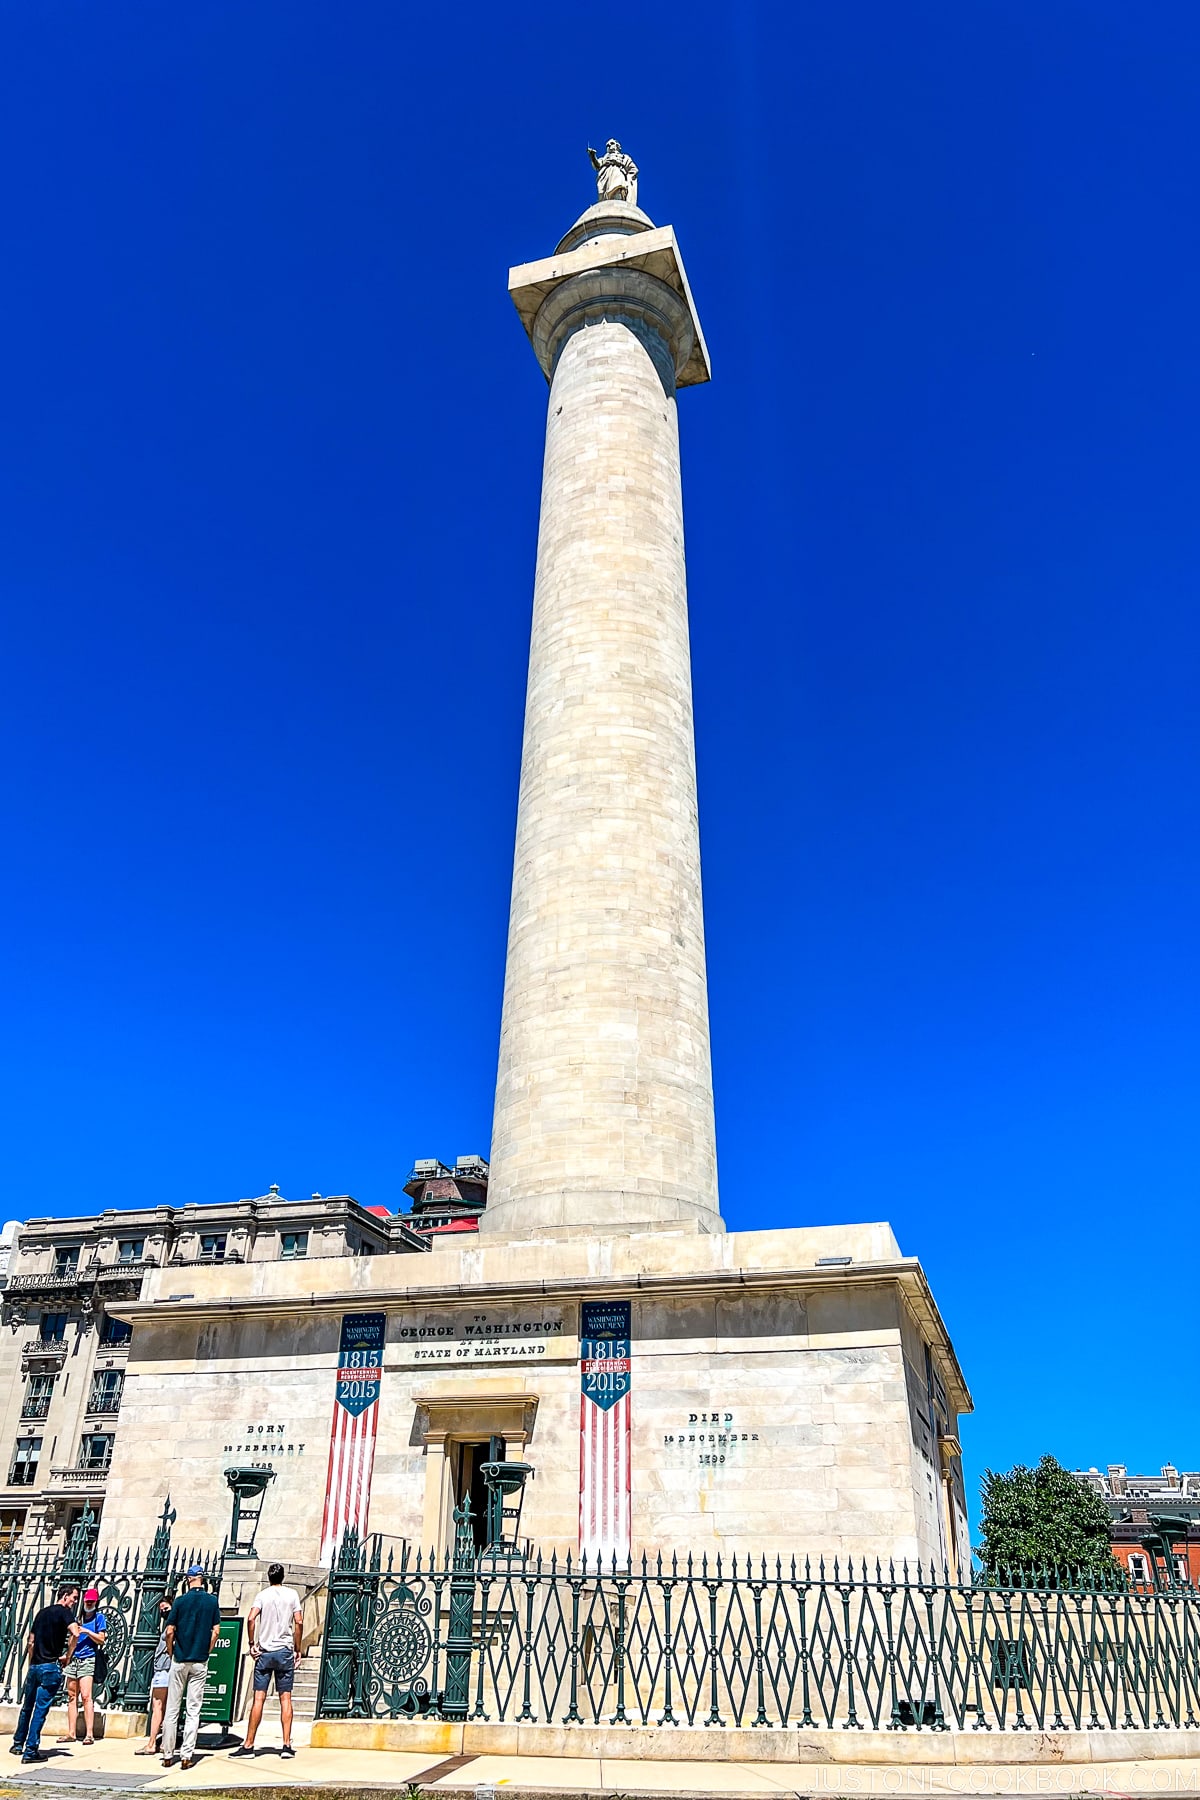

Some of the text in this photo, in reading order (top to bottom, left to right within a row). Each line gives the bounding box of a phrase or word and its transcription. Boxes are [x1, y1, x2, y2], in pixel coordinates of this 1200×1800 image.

[587, 1315, 626, 1324] WASHINGTON
[346, 1326, 380, 1335] WASHINGTON
[401, 1321, 563, 1338] GEORGE WASHINGTON
[588, 1321, 625, 1330] MONUMENT
[346, 1333, 380, 1341] MONUMENT
[414, 1345, 546, 1359] STATE OF MARYLAND
[586, 1341, 626, 1360] 1815
[343, 1350, 379, 1369] 1815
[586, 1372, 626, 1392] 2015
[340, 1381, 376, 1399] 2015
[689, 1413, 733, 1423] DIED
[247, 1424, 286, 1434] BORN
[678, 1433, 759, 1443] DECEMBER
[236, 1443, 306, 1452] FEBRUARY
[699, 1454, 726, 1464] 1799
